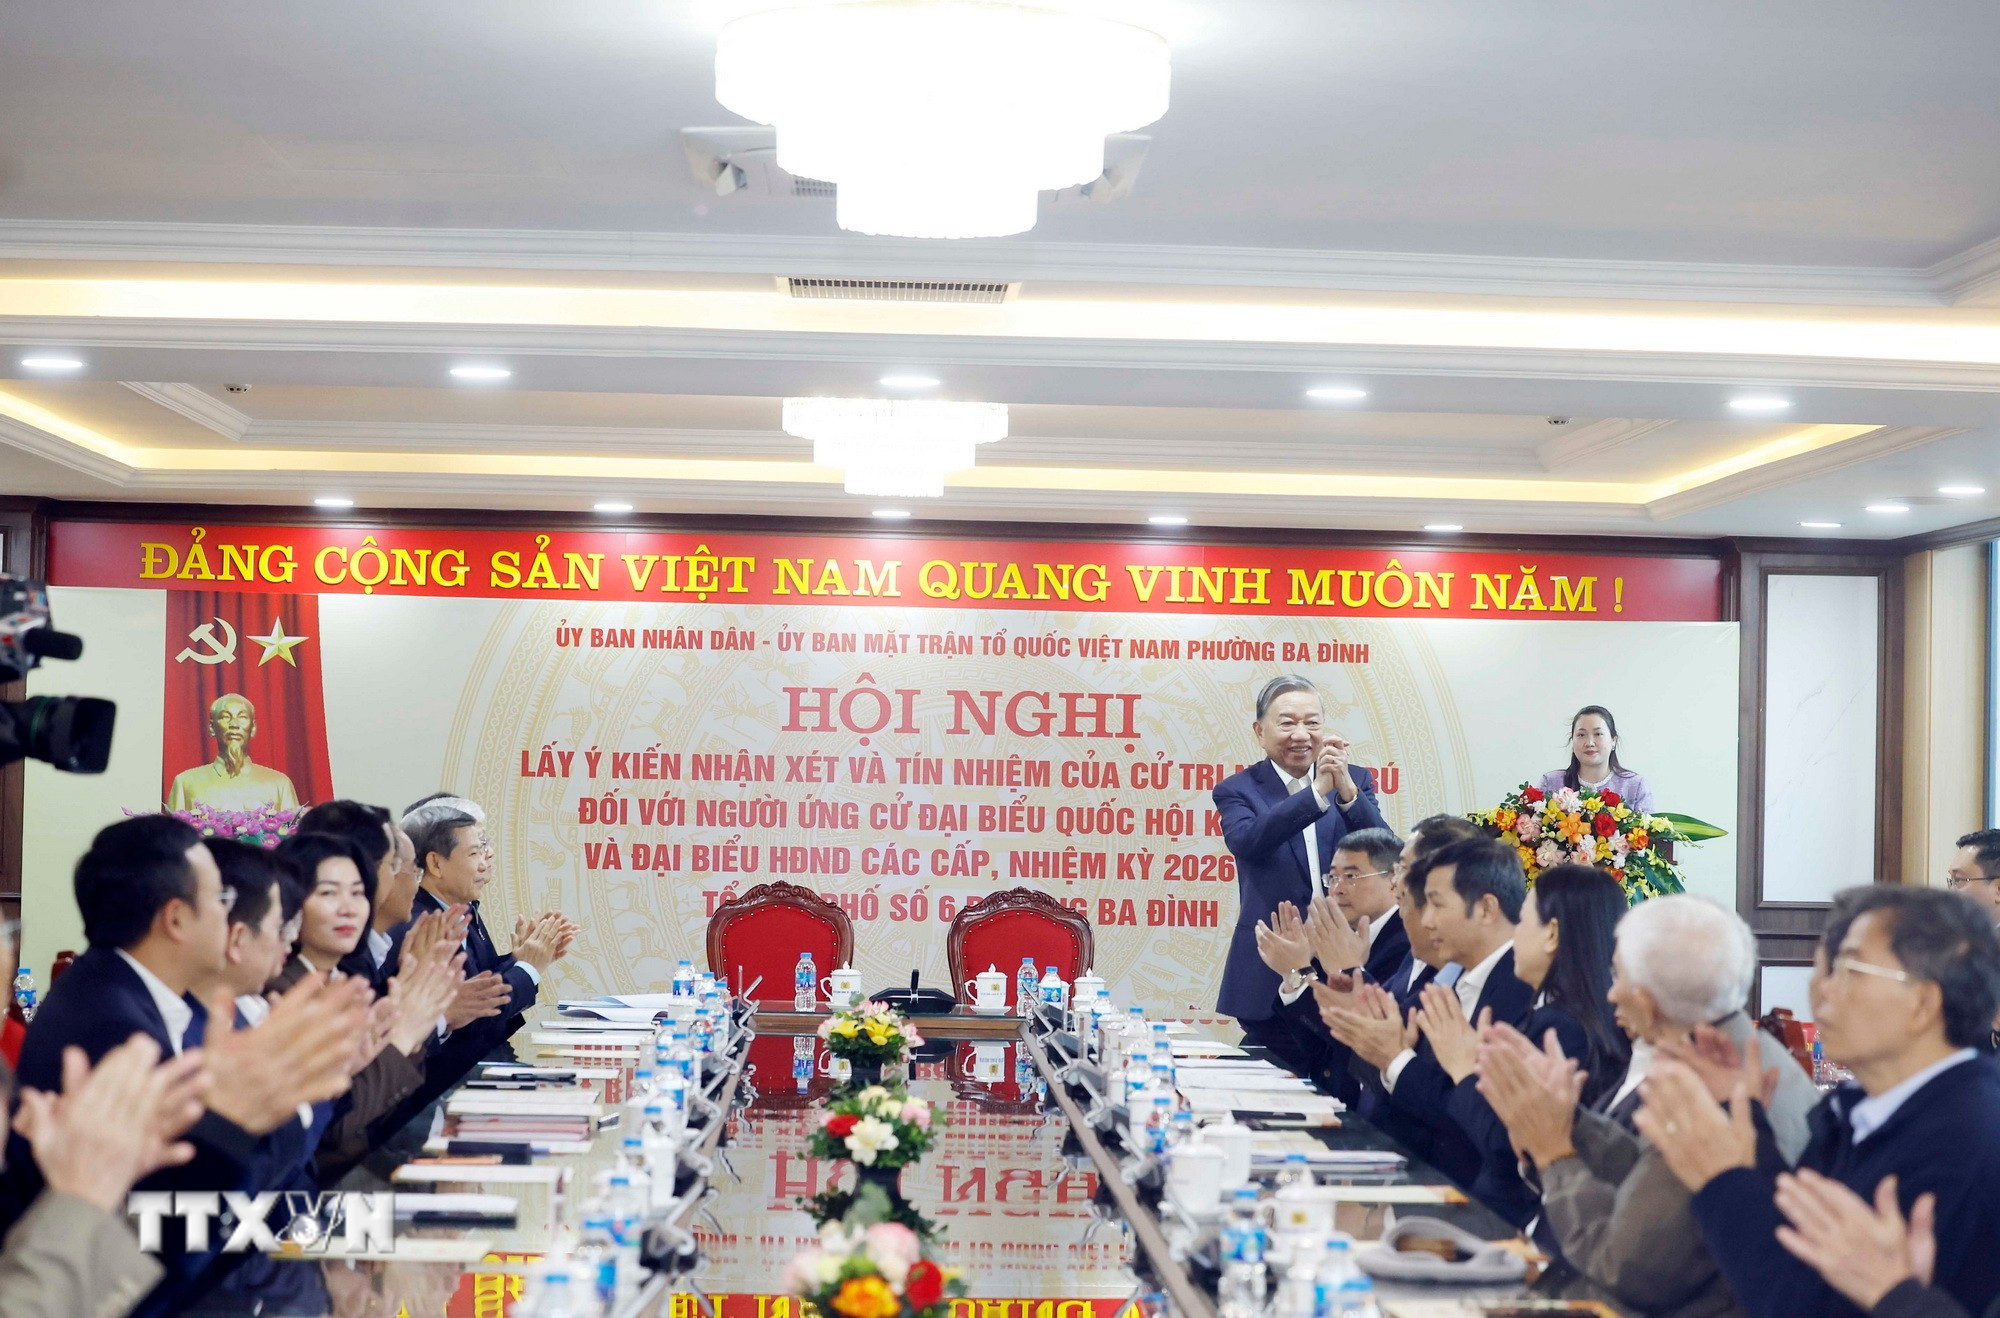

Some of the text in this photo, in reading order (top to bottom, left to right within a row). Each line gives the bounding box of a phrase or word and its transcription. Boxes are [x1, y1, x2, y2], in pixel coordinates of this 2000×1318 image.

[139, 527, 297, 583] ĐẢNG
[314, 536, 469, 595] CỘNG
[490, 534, 604, 590] SẢN
[621, 545, 756, 602] VIỆT
[772, 557, 901, 597] NAM
[918, 560, 1111, 602] QUANG
[1126, 564, 1271, 605] VINH
[1287, 559, 1455, 609] MUÔN
[1471, 564, 1597, 612] NĂM
[556, 618, 583, 648] ỦY
[590, 627, 636, 649] BAN
[642, 626, 703, 650] NHÂN
[711, 627, 755, 651] DÂN
[778, 623, 804, 651] ỦY
[812, 632, 857, 654] BAN
[864, 629, 909, 657] MẶT
[917, 631, 973, 659] TRẬN
[982, 627, 1006, 656] TỔ
[1014, 630, 1070, 658] QUỐC
[1078, 634, 1123, 662] VIỆT
[1129, 639, 1180, 660] NAM
[1187, 633, 1275, 662] PHƯỜNG
[1282, 641, 1311, 663] BA
[1317, 636, 1370, 664] ĐÌNH
[782, 672, 1142, 754] HỘI NGHỊ
[520, 741, 575, 778] LẤY
[584, 746, 602, 779] Ý
[612, 743, 681, 780] KIẾN
[691, 749, 776, 788] NHẬN
[785, 750, 839, 783] XÉT
[848, 752, 886, 785] VÀ
[896, 752, 943, 786] TÍN
[953, 755, 1050, 793] NHIỆM
[1061, 749, 1120, 789] CỦA
[1130, 750, 1173, 790] CỬ
[1179, 763, 1224, 790] TRI
[578, 788, 628, 825] ĐỐI
[638, 790, 686, 826] VỚI
[698, 793, 787, 829] NGƯỜI
[799, 793, 859, 830] ỨNG
[869, 791, 913, 832] CỬ
[918, 803, 969, 837] ĐẠI
[978, 794, 1046, 834] BIỂU
[1056, 798, 1135, 837] QUỐC
[1146, 803, 1194, 842] HỘI
[584, 838, 622, 870] VÀ
[631, 843, 681, 877] ĐẠI
[692, 834, 759, 873] BIỂU
[769, 846, 850, 875] HĐND
[861, 842, 920, 876] CÁC
[930, 839, 998, 881] CẤP,
[1009, 846, 1107, 885] NHIỆM
[1117, 847, 1154, 881] KỲ
[890, 885, 930, 922] SỐ
[938, 896, 956, 923] 6
[1098, 899, 1138, 926] BA
[1146, 893, 1218, 927] ĐÌNH
